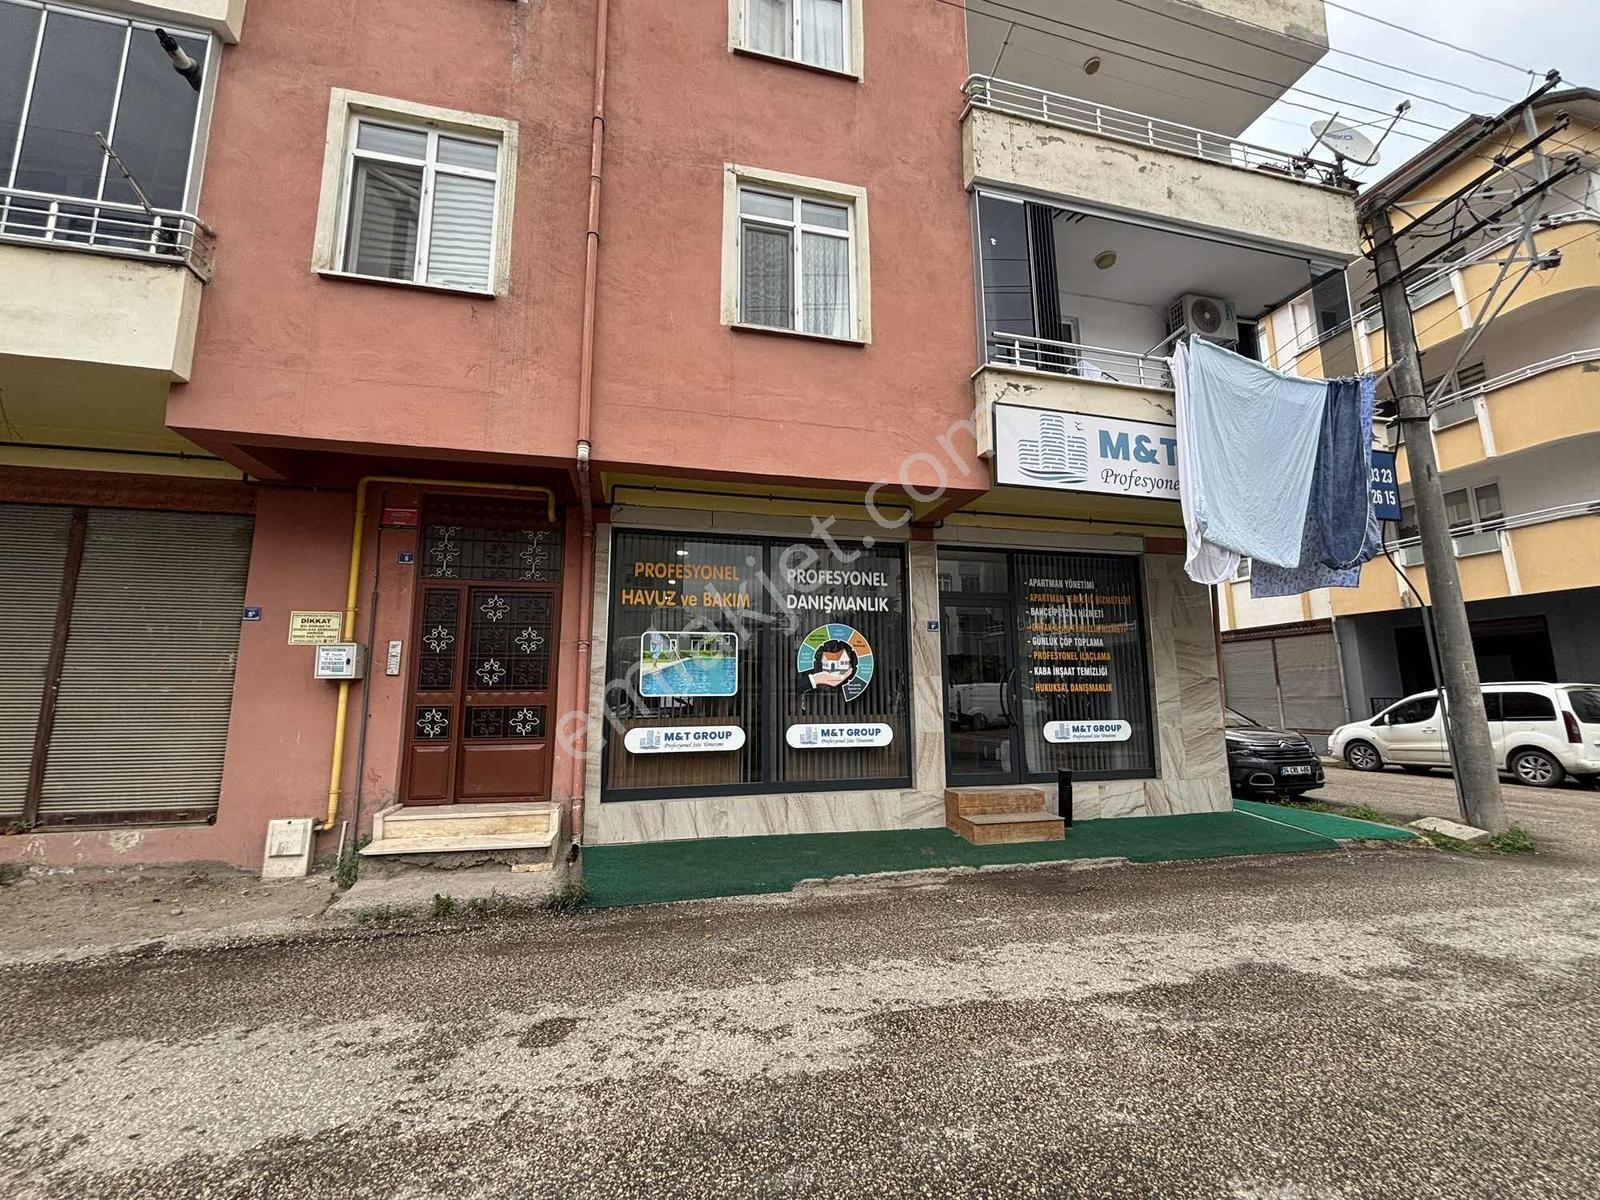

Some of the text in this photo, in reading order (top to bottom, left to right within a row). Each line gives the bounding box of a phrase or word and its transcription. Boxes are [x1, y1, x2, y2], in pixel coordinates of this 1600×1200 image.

[1381, 469, 1393, 483] 23
[1385, 491, 1396, 505] 15
[634, 562, 740, 580] PROFESYONEL
[787, 569, 888, 586] PROFESYONEL
[1028, 579, 1063, 587] APARTMAN
[621, 589, 750, 608] HAVUZ ve BAKIM
[786, 594, 889, 613] DANIŞMANLIK
[1032, 636, 1104, 648] GÜNLÜK ÇÖP TOPLAMA
[1033, 651, 1079, 660] PROFESYONEL
[1034, 665, 1108, 678] KABA İNŞAAT TEMİZLİĞİ
[1035, 682, 1113, 694] HUKUKSAL DANIŞMANLIK
[821, 728, 881, 737] M&T GROUP
[1072, 724, 1122, 733] M&T GROUP
[664, 731, 733, 741] M&T GROUP
